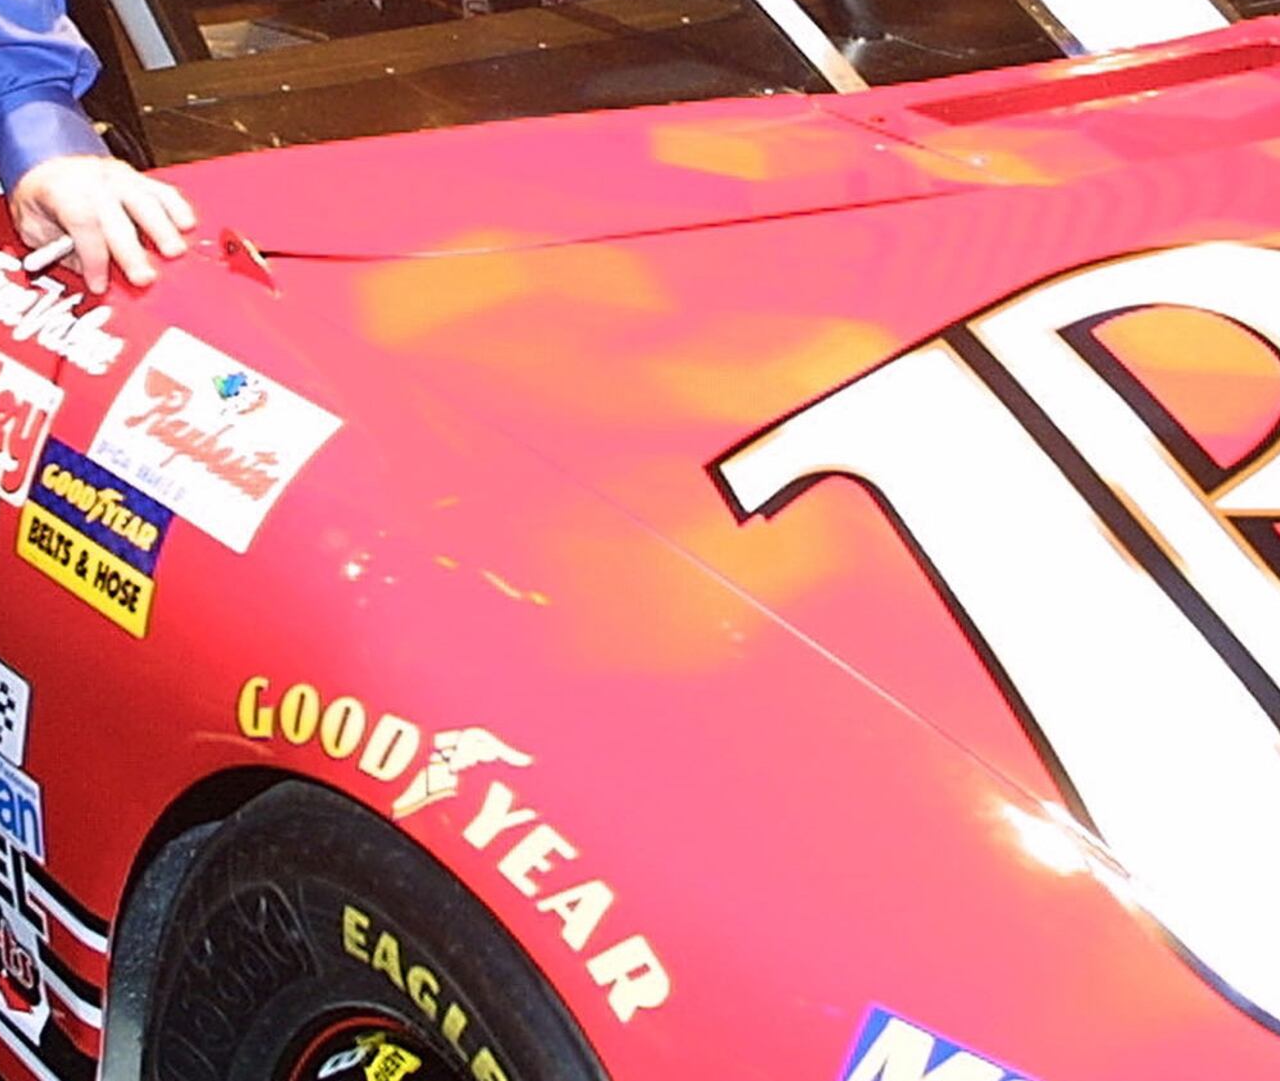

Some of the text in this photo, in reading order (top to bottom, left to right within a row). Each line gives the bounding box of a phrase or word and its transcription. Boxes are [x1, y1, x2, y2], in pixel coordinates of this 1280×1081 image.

[28, 516, 141, 613] BELTS & HOSE
